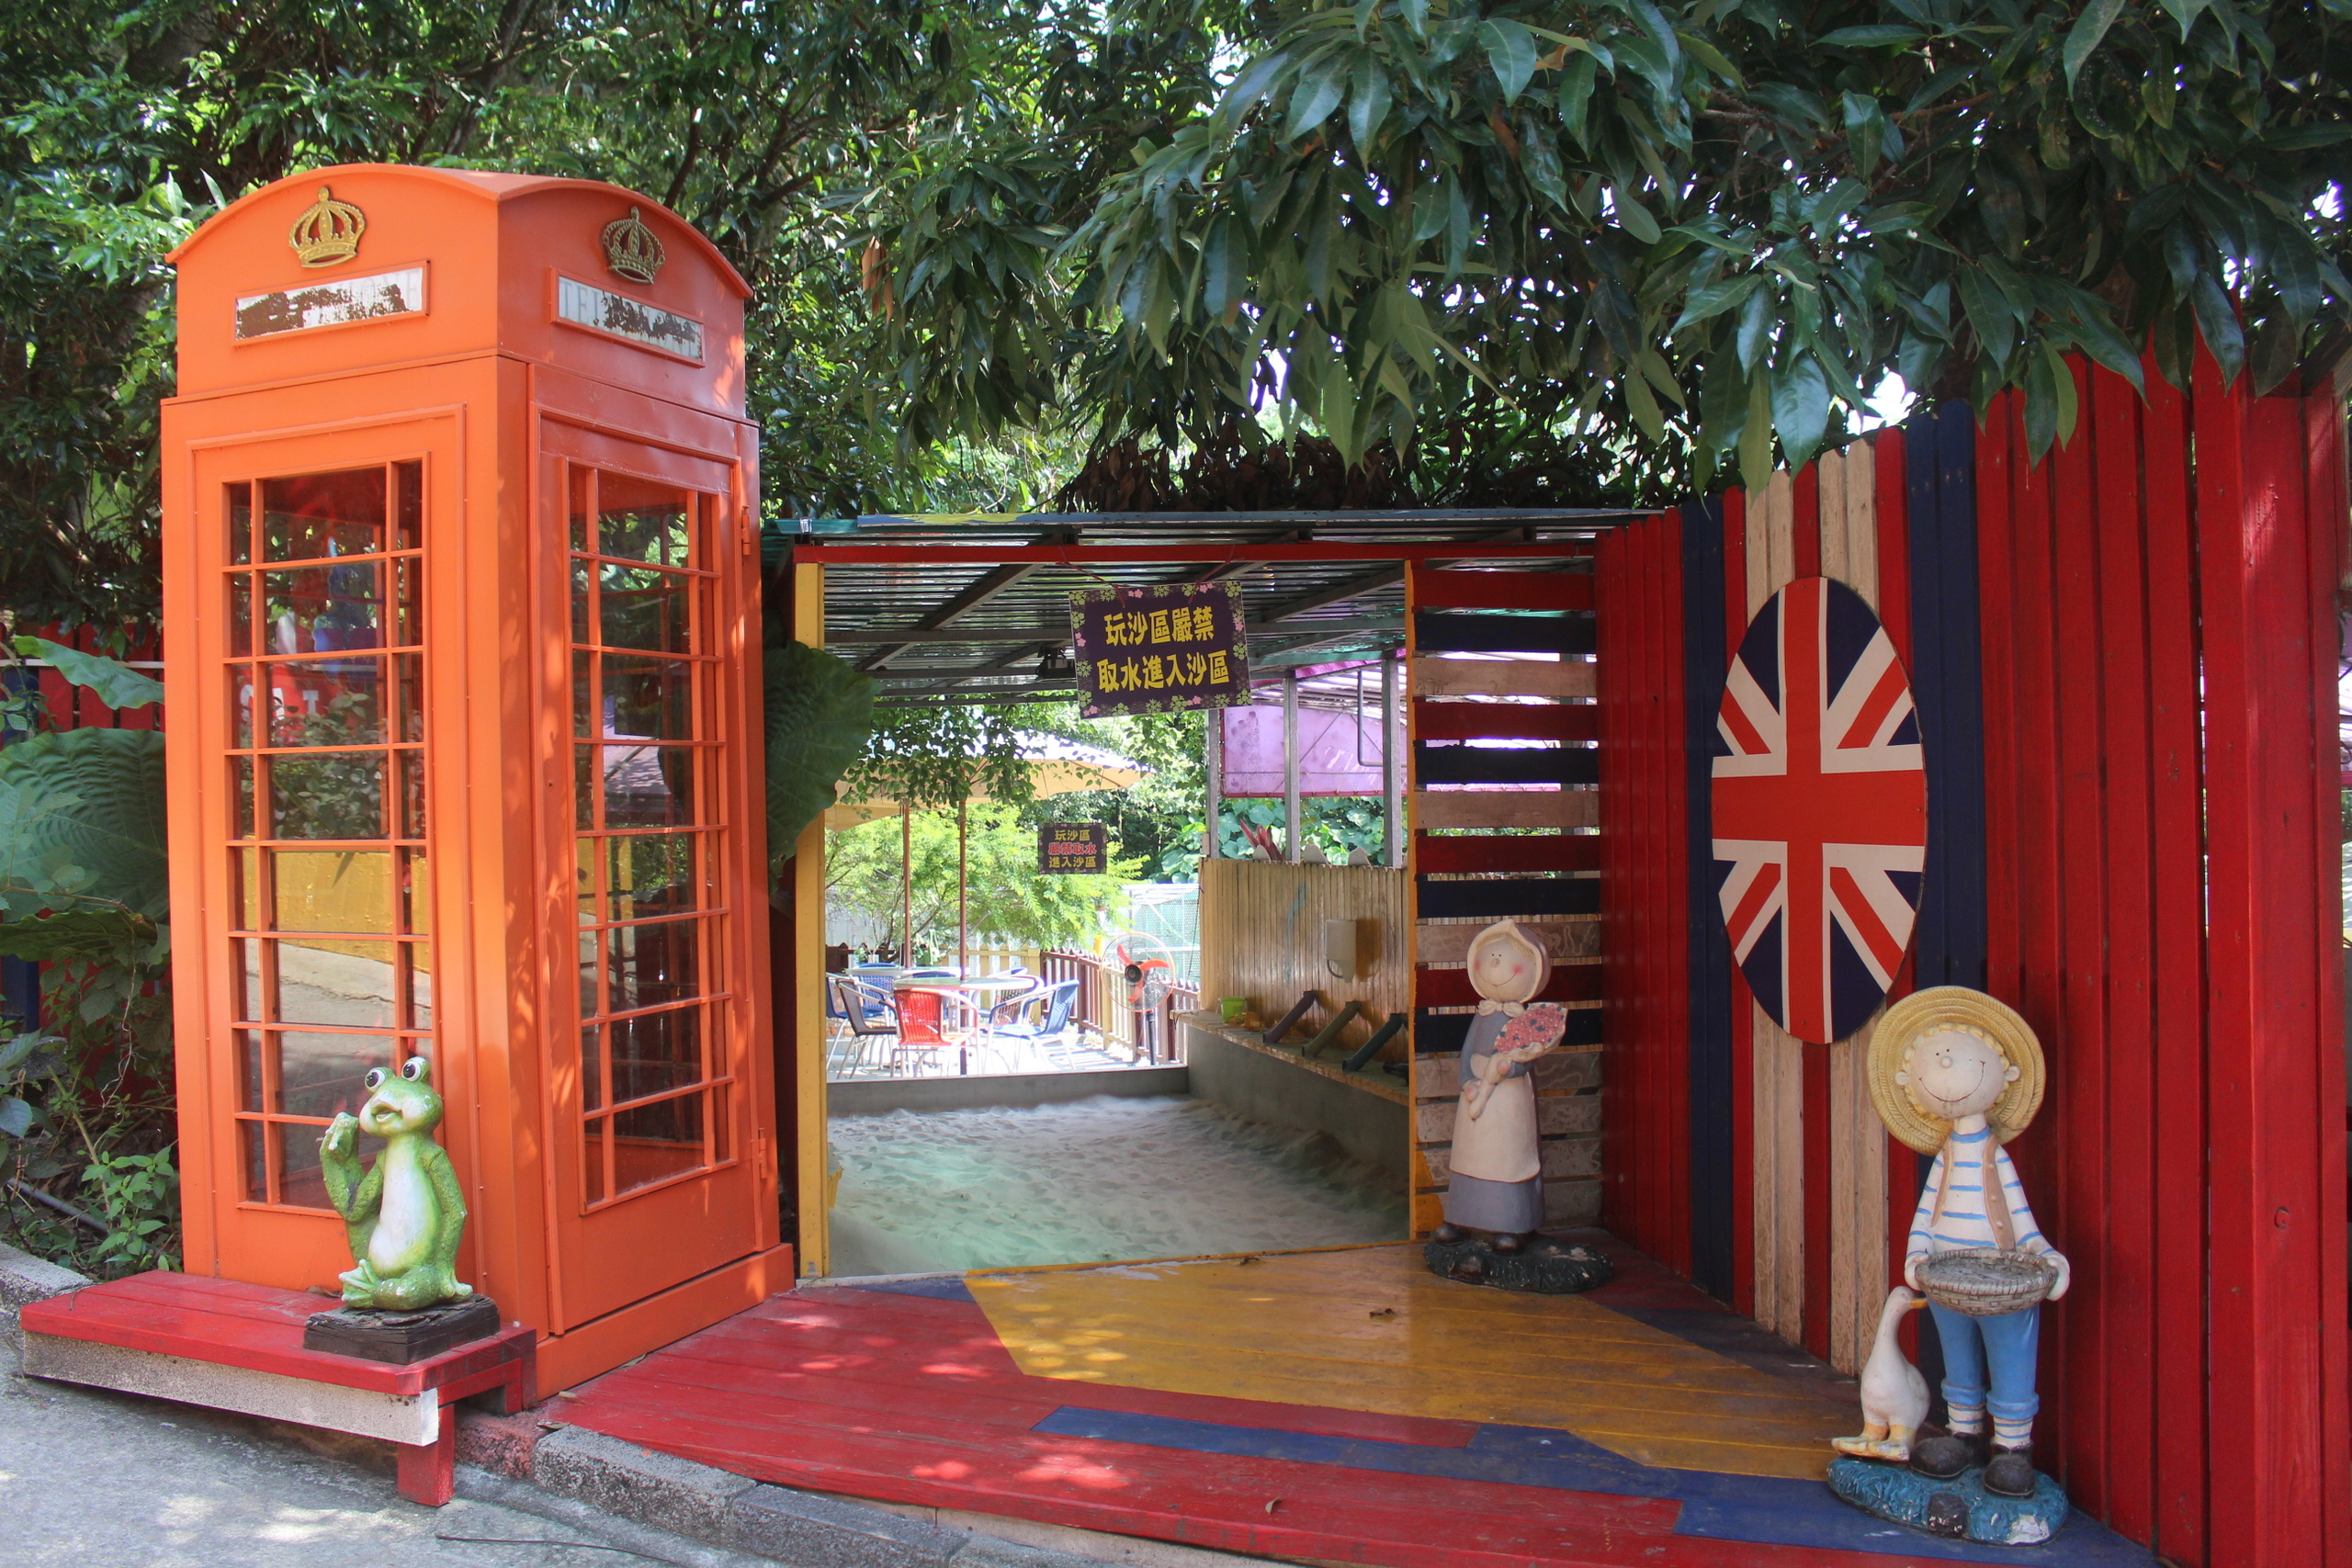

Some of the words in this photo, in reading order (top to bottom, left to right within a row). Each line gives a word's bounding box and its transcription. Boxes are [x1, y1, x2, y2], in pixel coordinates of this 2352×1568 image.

[1103, 606, 1215, 647] 玩沙區嚴禁
[1096, 649, 1230, 694] 取水進入沙區
[1055, 829, 1091, 841] 玩沙區
[1048, 856, 1097, 868] 進入沙區
